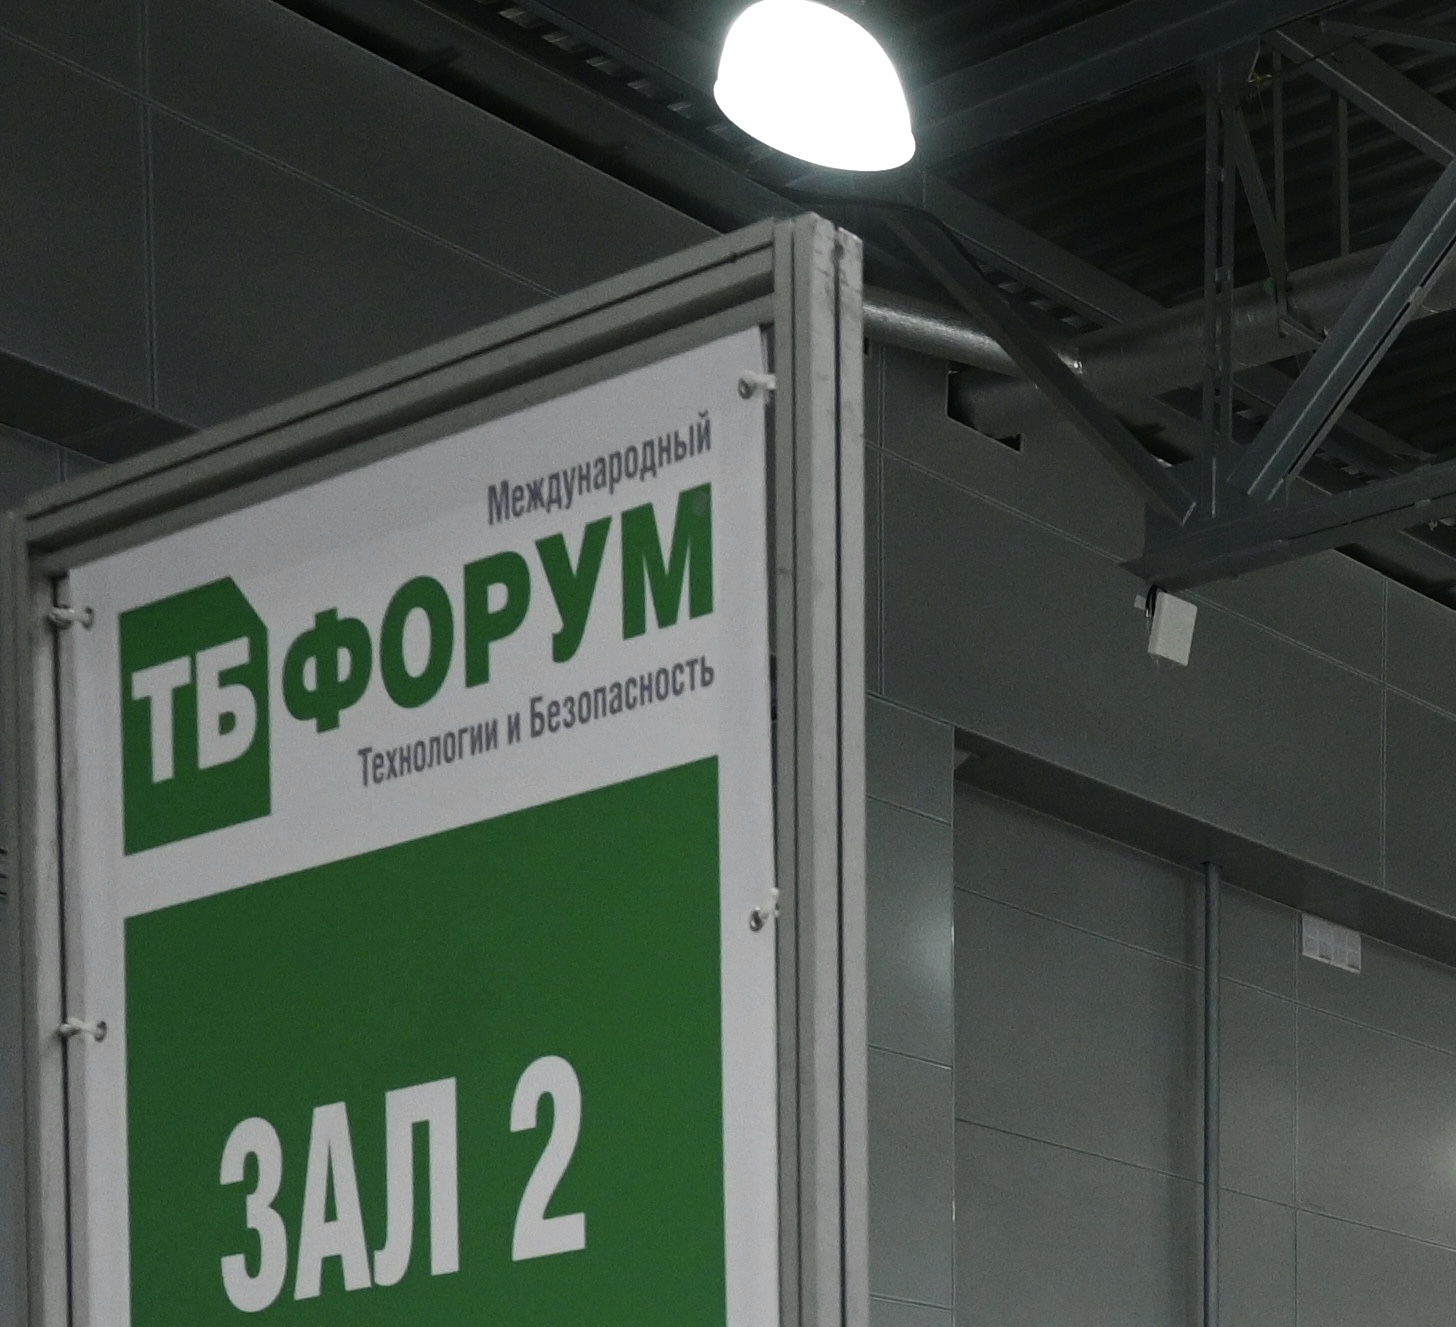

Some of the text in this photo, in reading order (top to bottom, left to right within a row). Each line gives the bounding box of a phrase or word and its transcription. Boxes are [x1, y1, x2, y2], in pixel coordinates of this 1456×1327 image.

[487, 410, 712, 525] Международный
[357, 657, 714, 786] Технологии и Безопасность
[220, 1056, 586, 1312] ЗАЛ 2
